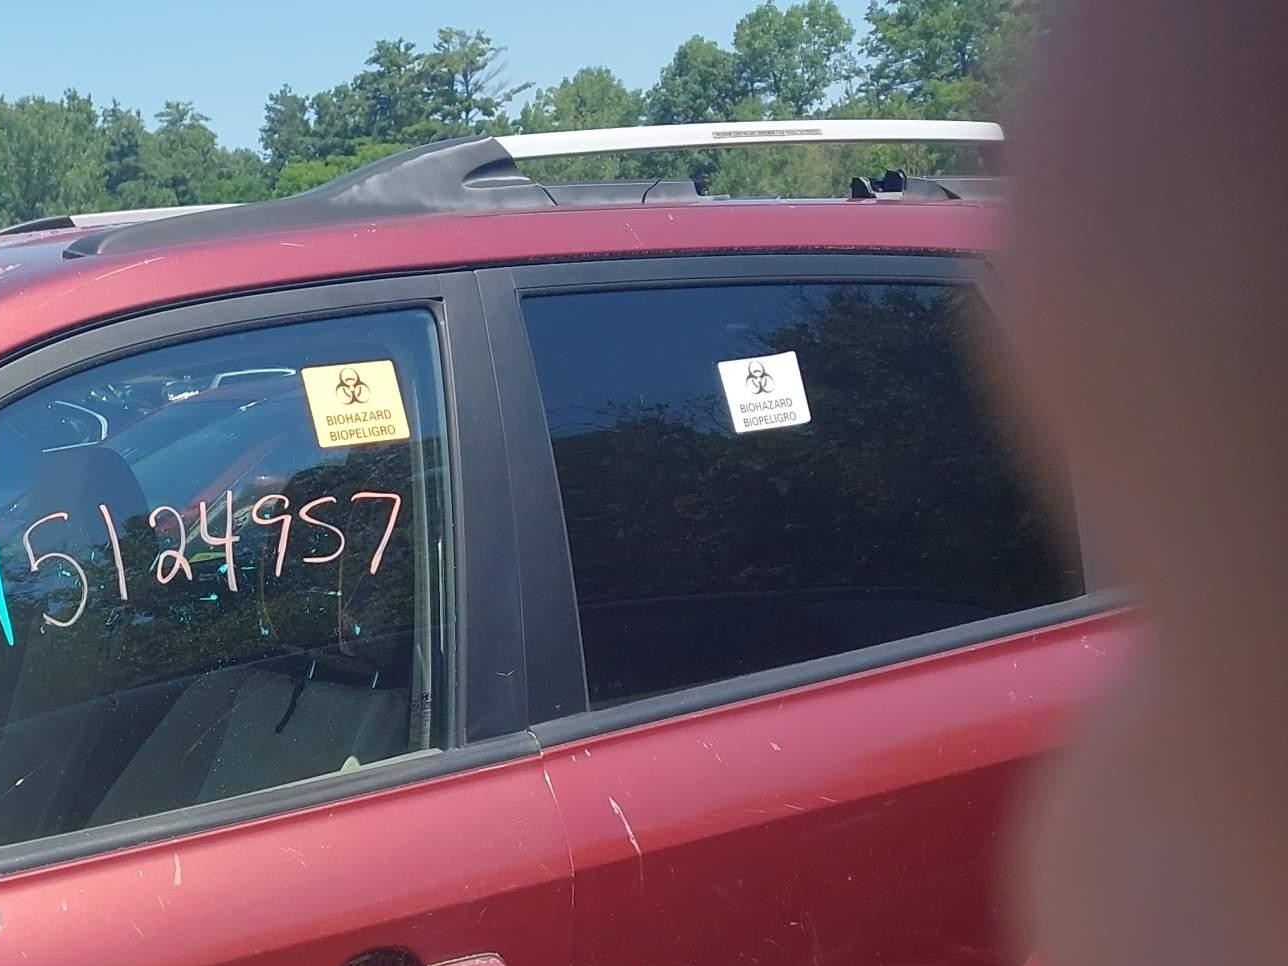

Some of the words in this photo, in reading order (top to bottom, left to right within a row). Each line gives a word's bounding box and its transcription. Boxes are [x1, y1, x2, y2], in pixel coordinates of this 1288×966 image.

[738, 397, 794, 414] BIOHAZARD
[325, 409, 393, 427] BIOHAZARD
[742, 411, 798, 428] BIOPELIGRO
[328, 424, 397, 442] BIOPELIGRO
